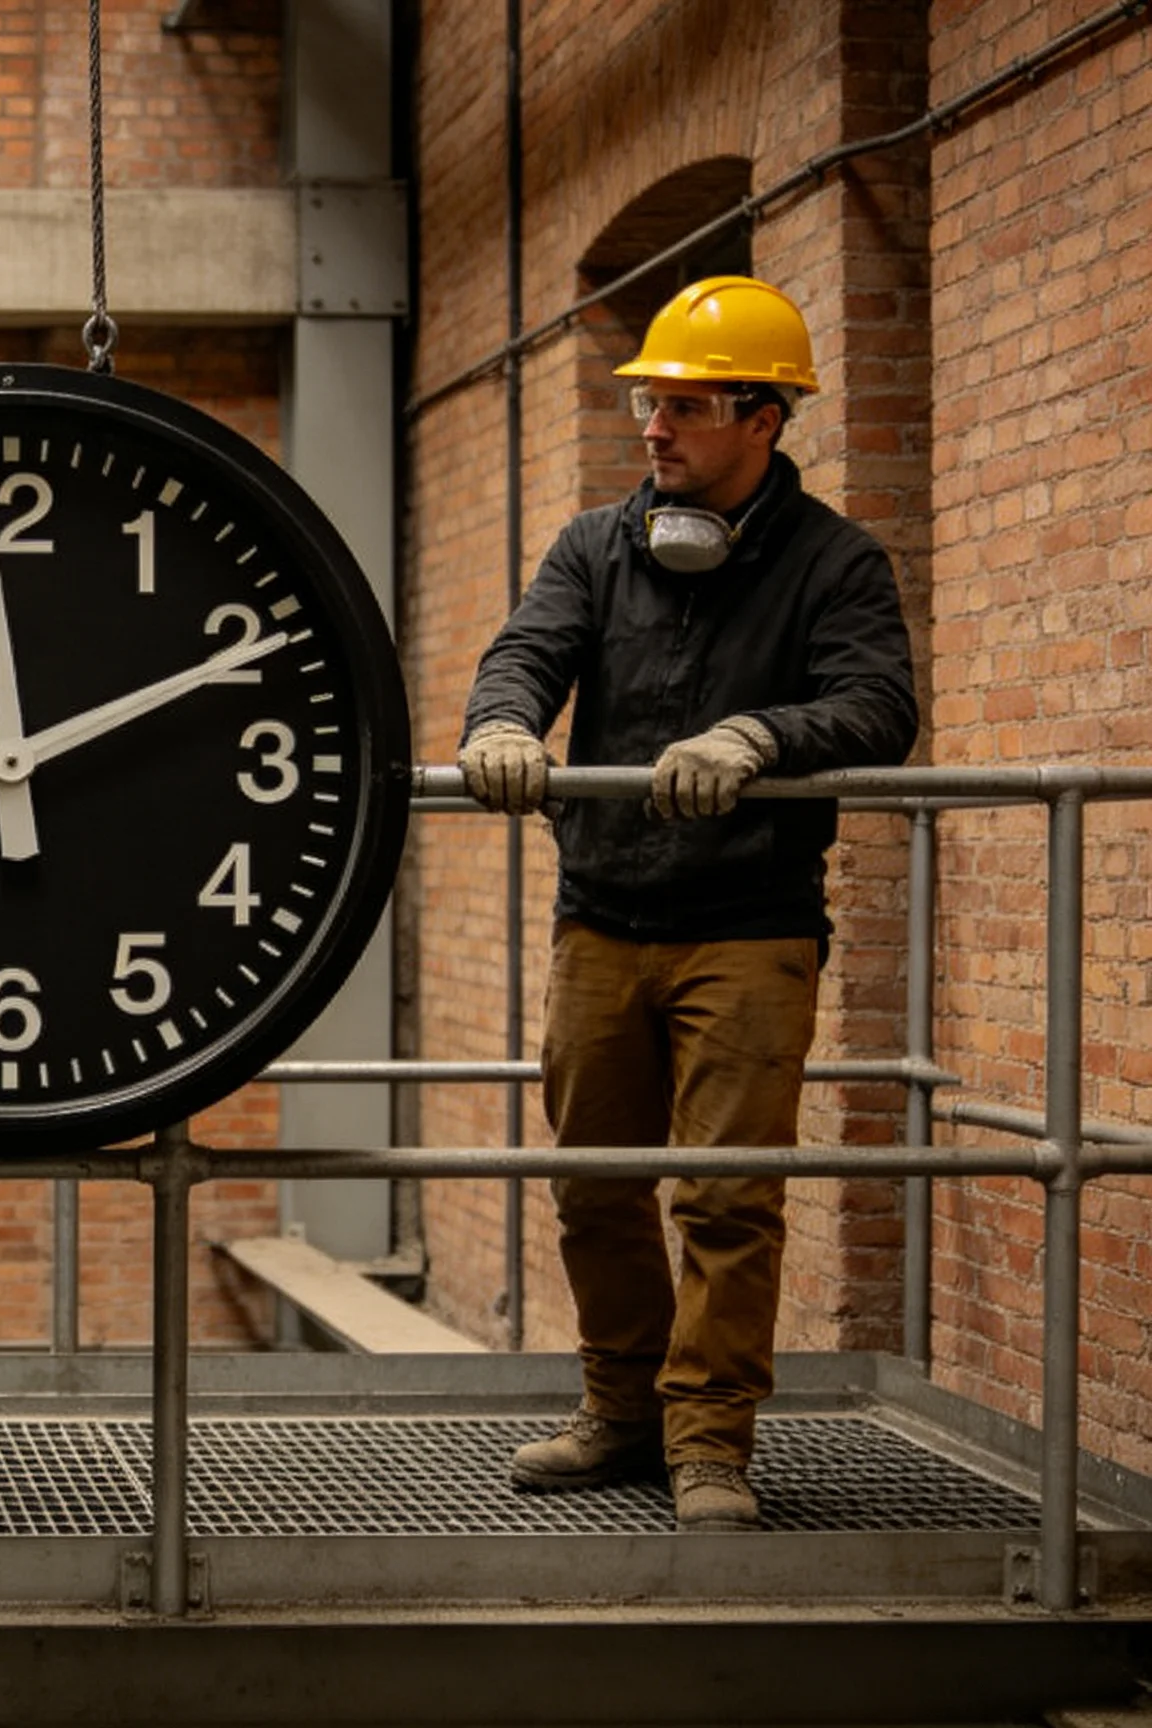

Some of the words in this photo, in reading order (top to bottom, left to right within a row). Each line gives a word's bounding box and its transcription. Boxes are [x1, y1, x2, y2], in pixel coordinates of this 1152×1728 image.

[121, 510, 155, 593] 1
[203, 602, 262, 684] 2
[236, 720, 300, 804] 3
[197, 843, 261, 926] 4
[109, 932, 172, 1016] 5
